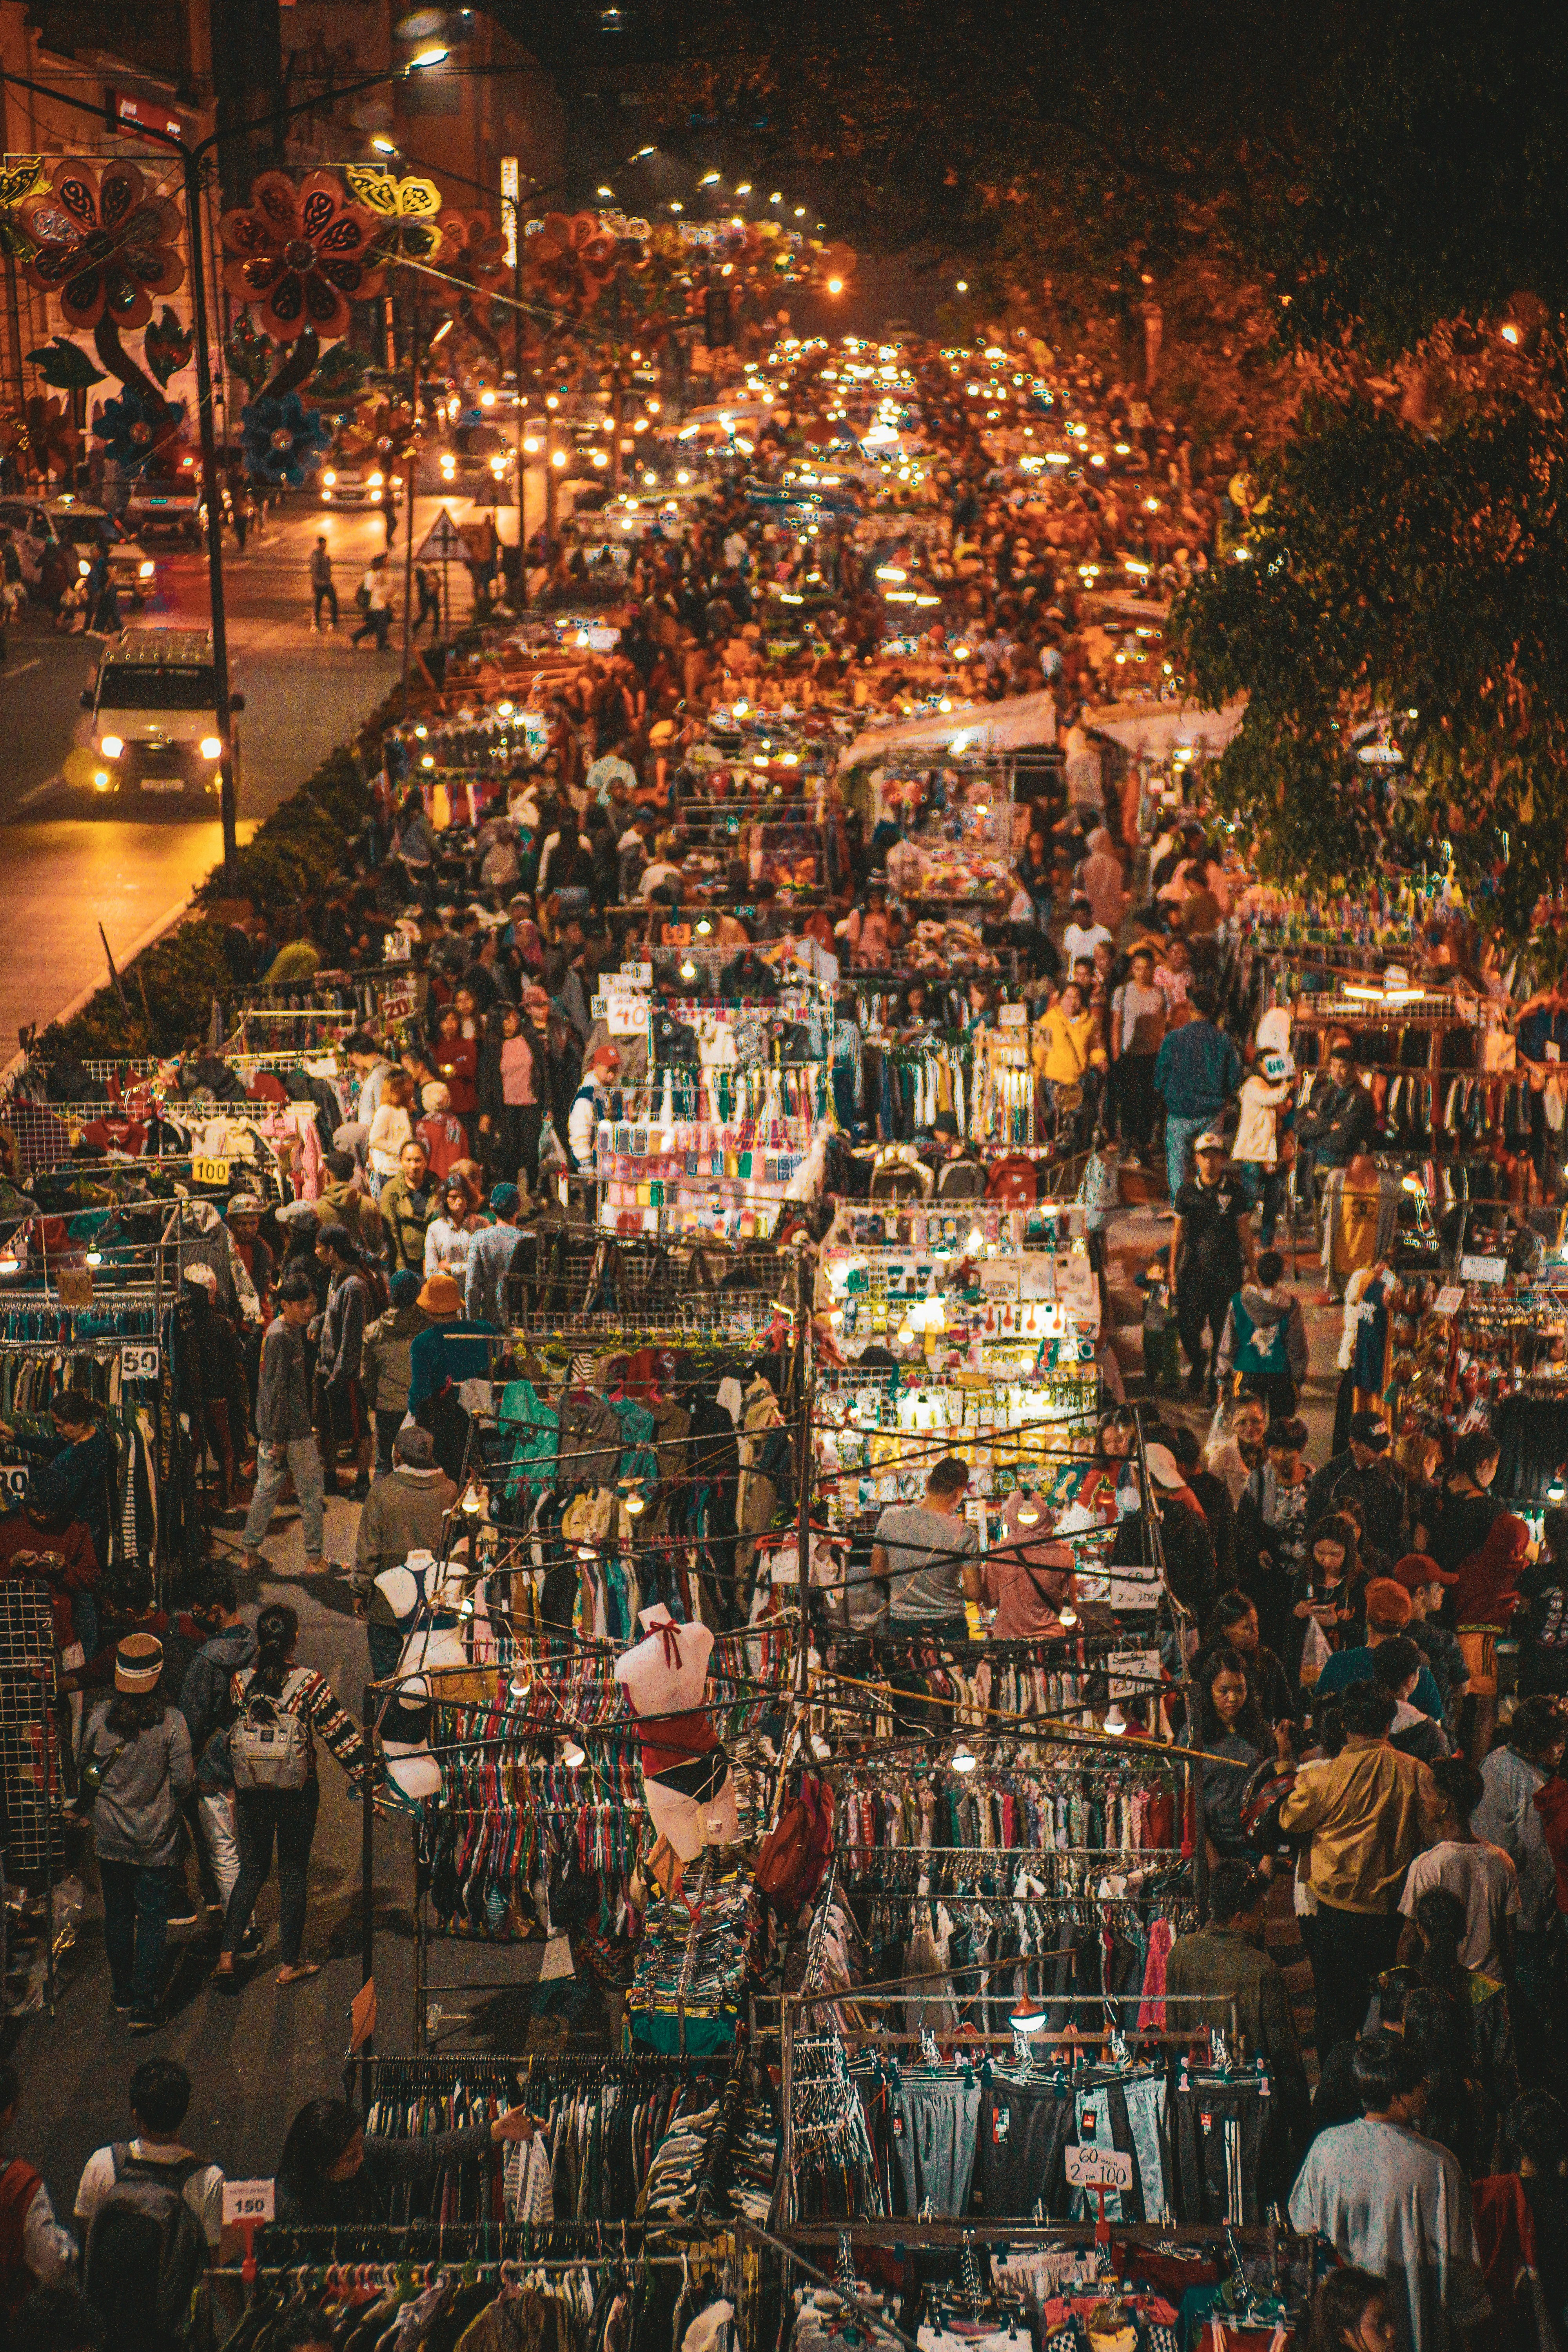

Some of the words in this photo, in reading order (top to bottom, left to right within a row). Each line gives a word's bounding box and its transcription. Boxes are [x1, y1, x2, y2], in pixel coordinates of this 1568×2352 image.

[384, 999, 408, 1019] 20
[614, 1005, 647, 1026] 40
[196, 1162, 227, 1180] 100
[123, 1351, 157, 1372] 50
[1078, 2148, 1098, 2163] 60
[1070, 2163, 1084, 2180] 2
[1100, 2165, 1127, 2185] 100
[236, 2198, 265, 2212] 150
